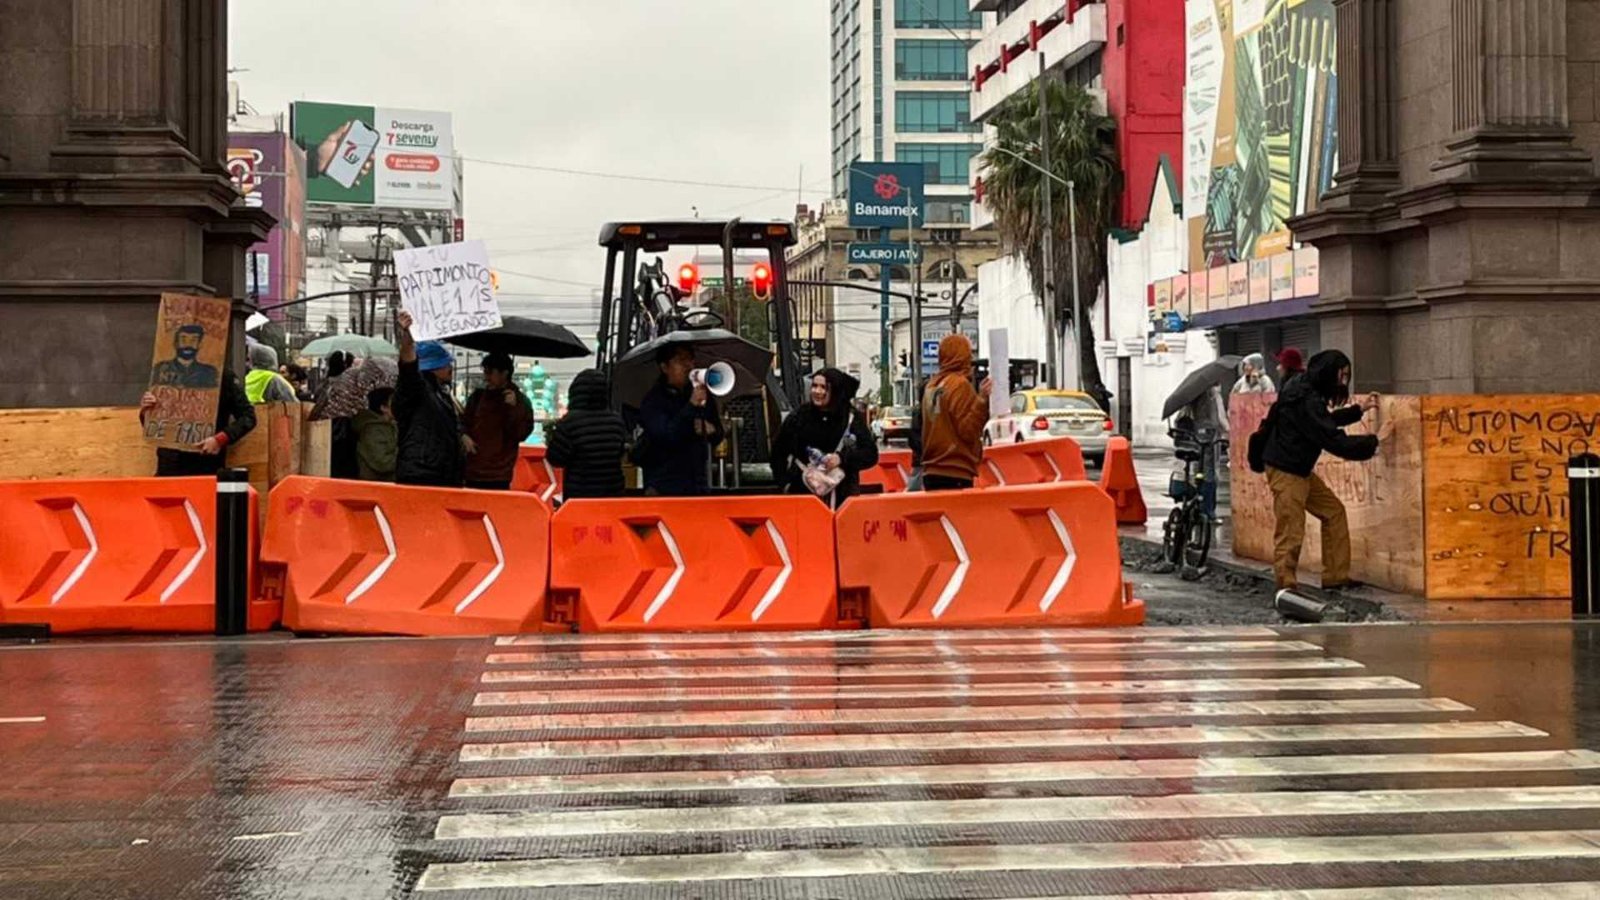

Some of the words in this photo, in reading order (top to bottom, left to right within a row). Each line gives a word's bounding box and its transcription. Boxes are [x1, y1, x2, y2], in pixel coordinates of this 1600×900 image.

[391, 120, 434, 132] Descarga
[855, 203, 918, 216] Banamex
[852, 249, 892, 259] CAJERO
[400, 262, 491, 298] PATRIMONIO
[435, 312, 496, 334] SEGUNDOS
[1467, 436, 1525, 455] QUE
[1541, 437, 1590, 457] NO
